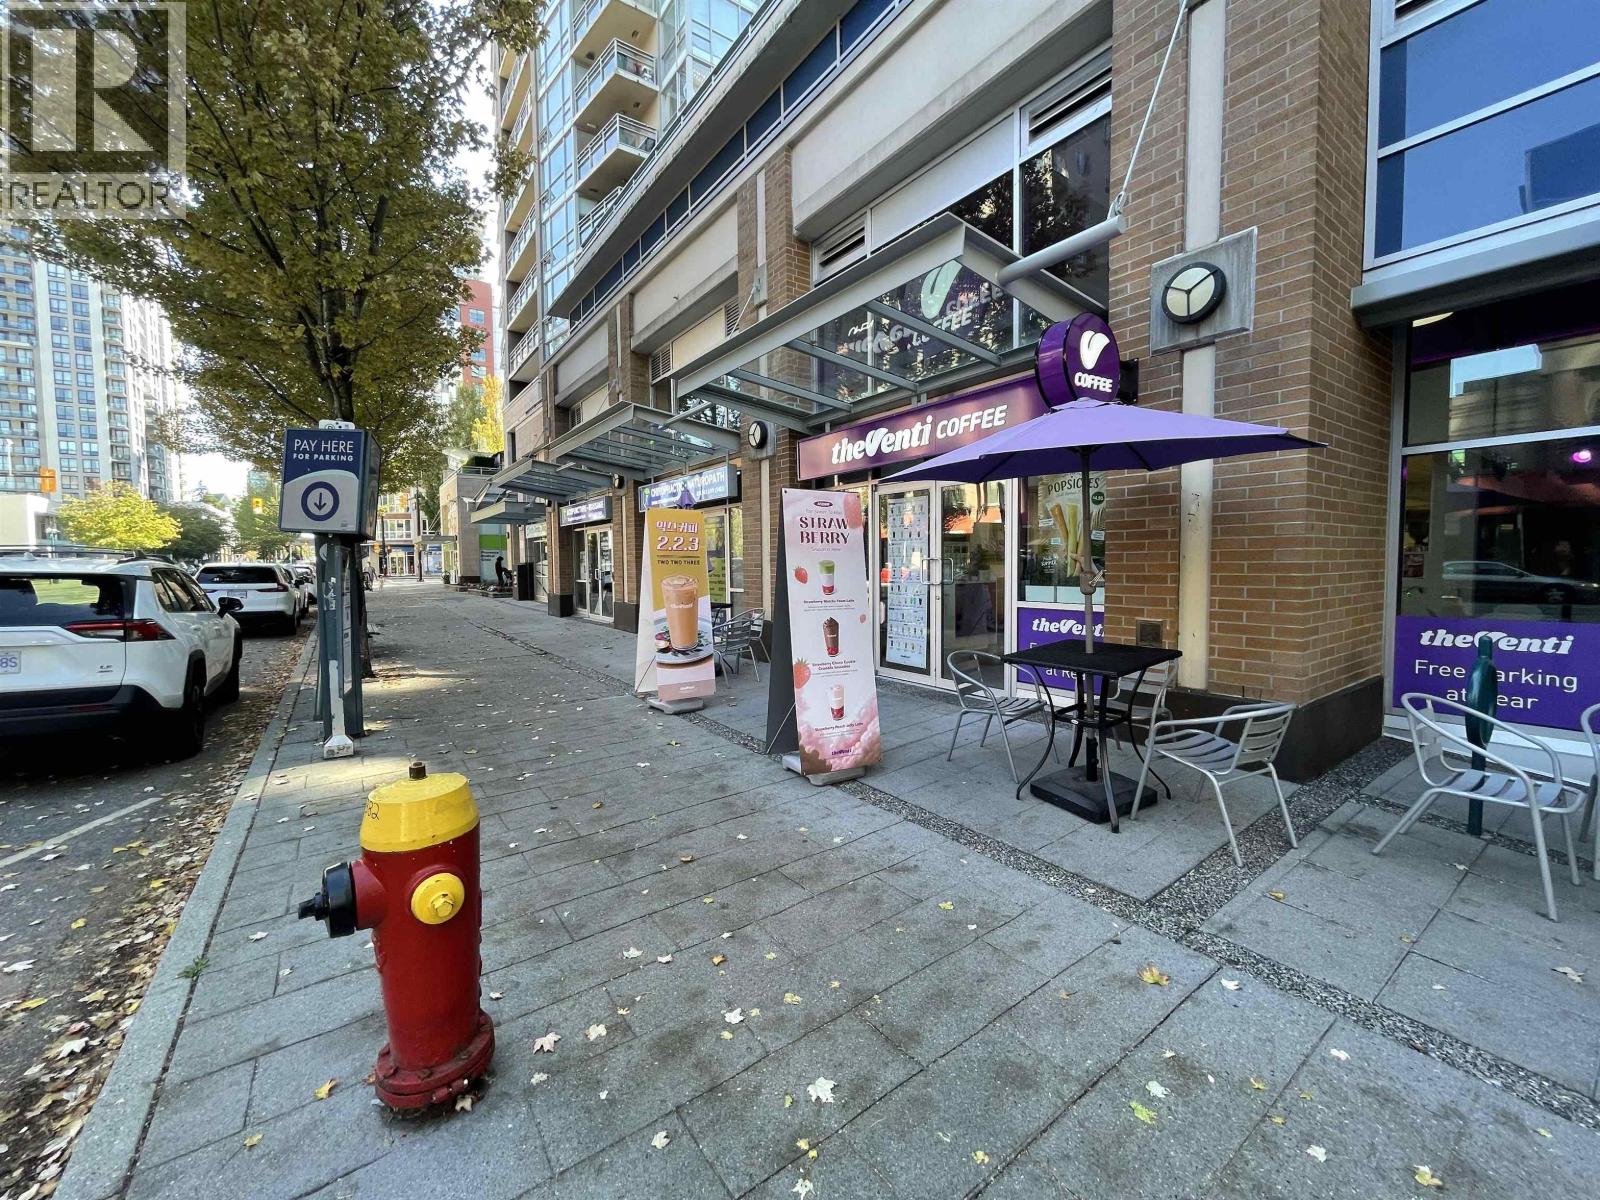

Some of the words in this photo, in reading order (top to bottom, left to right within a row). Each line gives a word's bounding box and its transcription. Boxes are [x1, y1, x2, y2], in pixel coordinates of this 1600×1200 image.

[1074, 371, 1113, 393] COFFEE
[831, 415, 933, 465] theVenti
[936, 404, 1008, 440] COFFEE
[294, 439, 317, 452] PAY
[321, 441, 354, 453] HERE
[313, 454, 354, 462] PARKING
[1047, 477, 1100, 495] POPSICES
[799, 516, 849, 530] STRAW
[656, 535, 700, 551] 2.2.3
[800, 531, 850, 544] BERRY
[1415, 659, 1466, 678] Free
[1496, 668, 1578, 693] arking
[1496, 694, 1539, 710] ear
